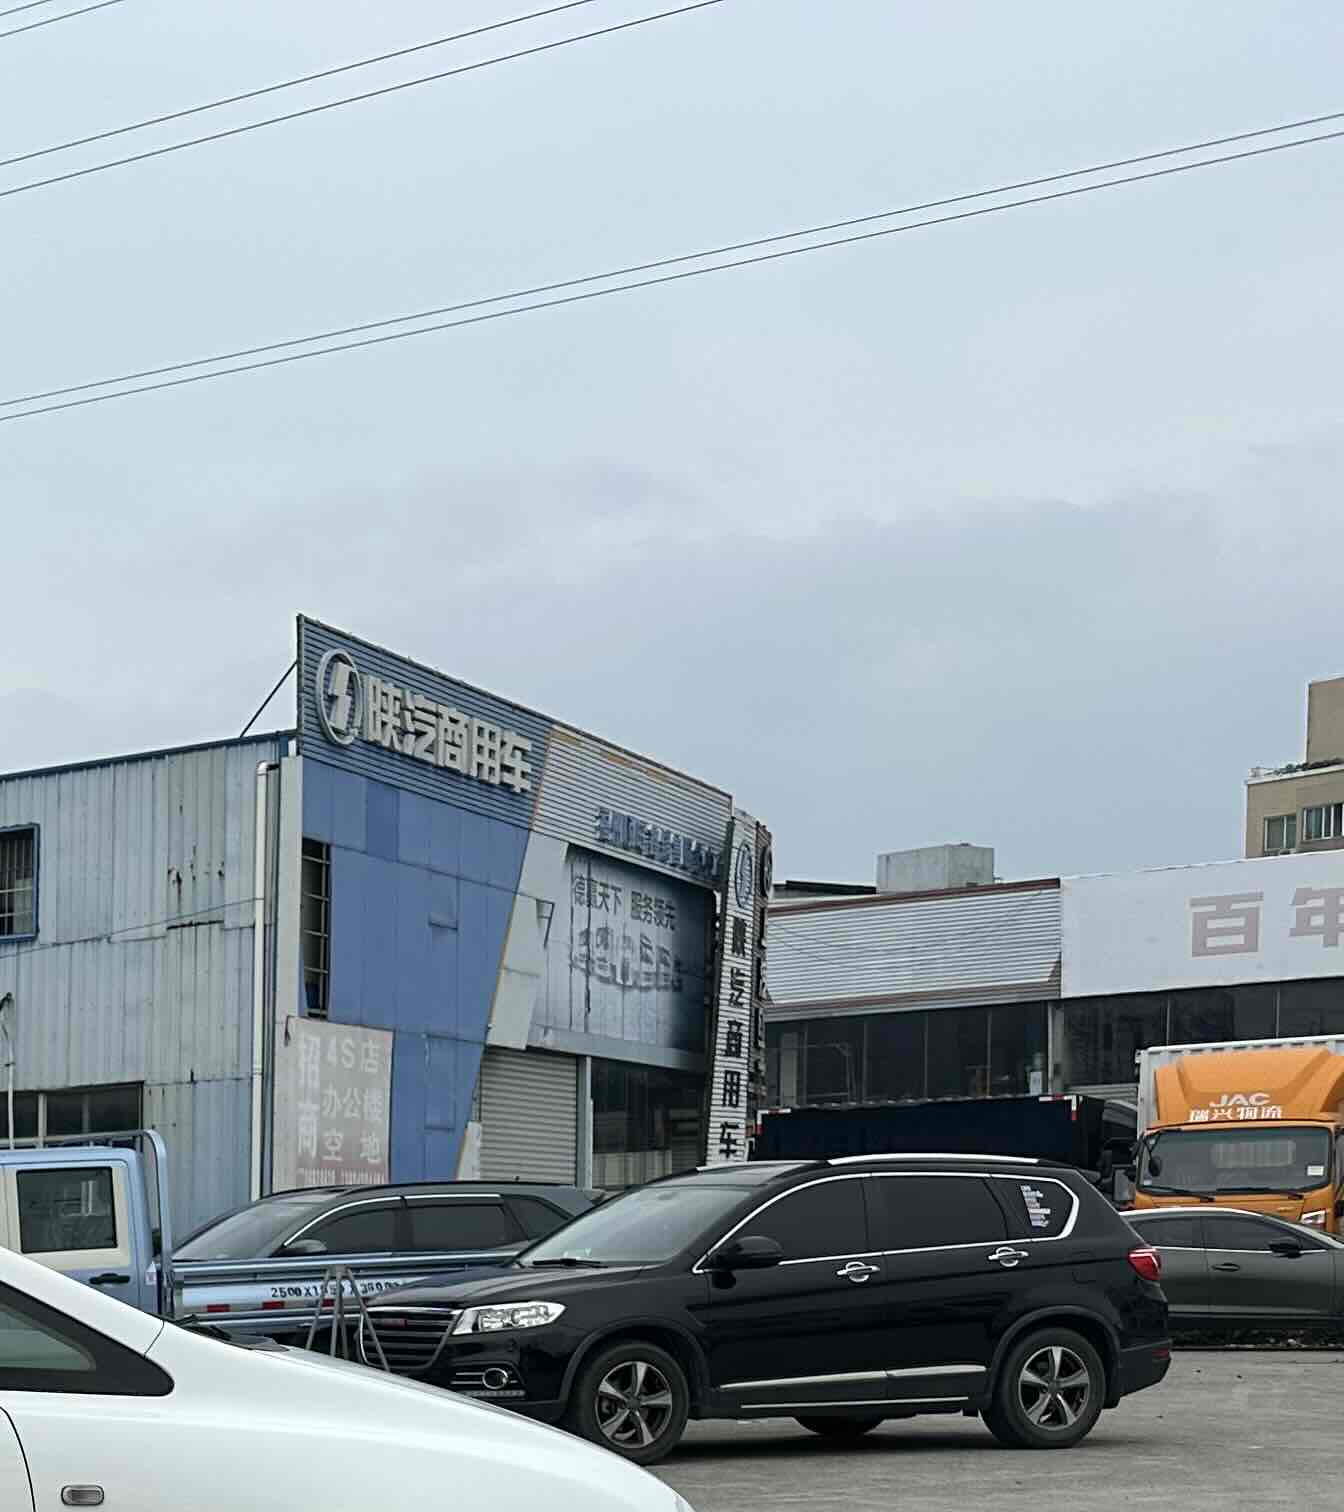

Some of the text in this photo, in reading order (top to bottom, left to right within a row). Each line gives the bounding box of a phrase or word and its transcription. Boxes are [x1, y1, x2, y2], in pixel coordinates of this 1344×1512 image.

[365, 675, 532, 794] 陕汽商用车
[322, 1036, 380, 1074] 4S店
[322, 1083, 383, 1123] 办公楼
[1209, 1092, 1271, 1108] JAC
